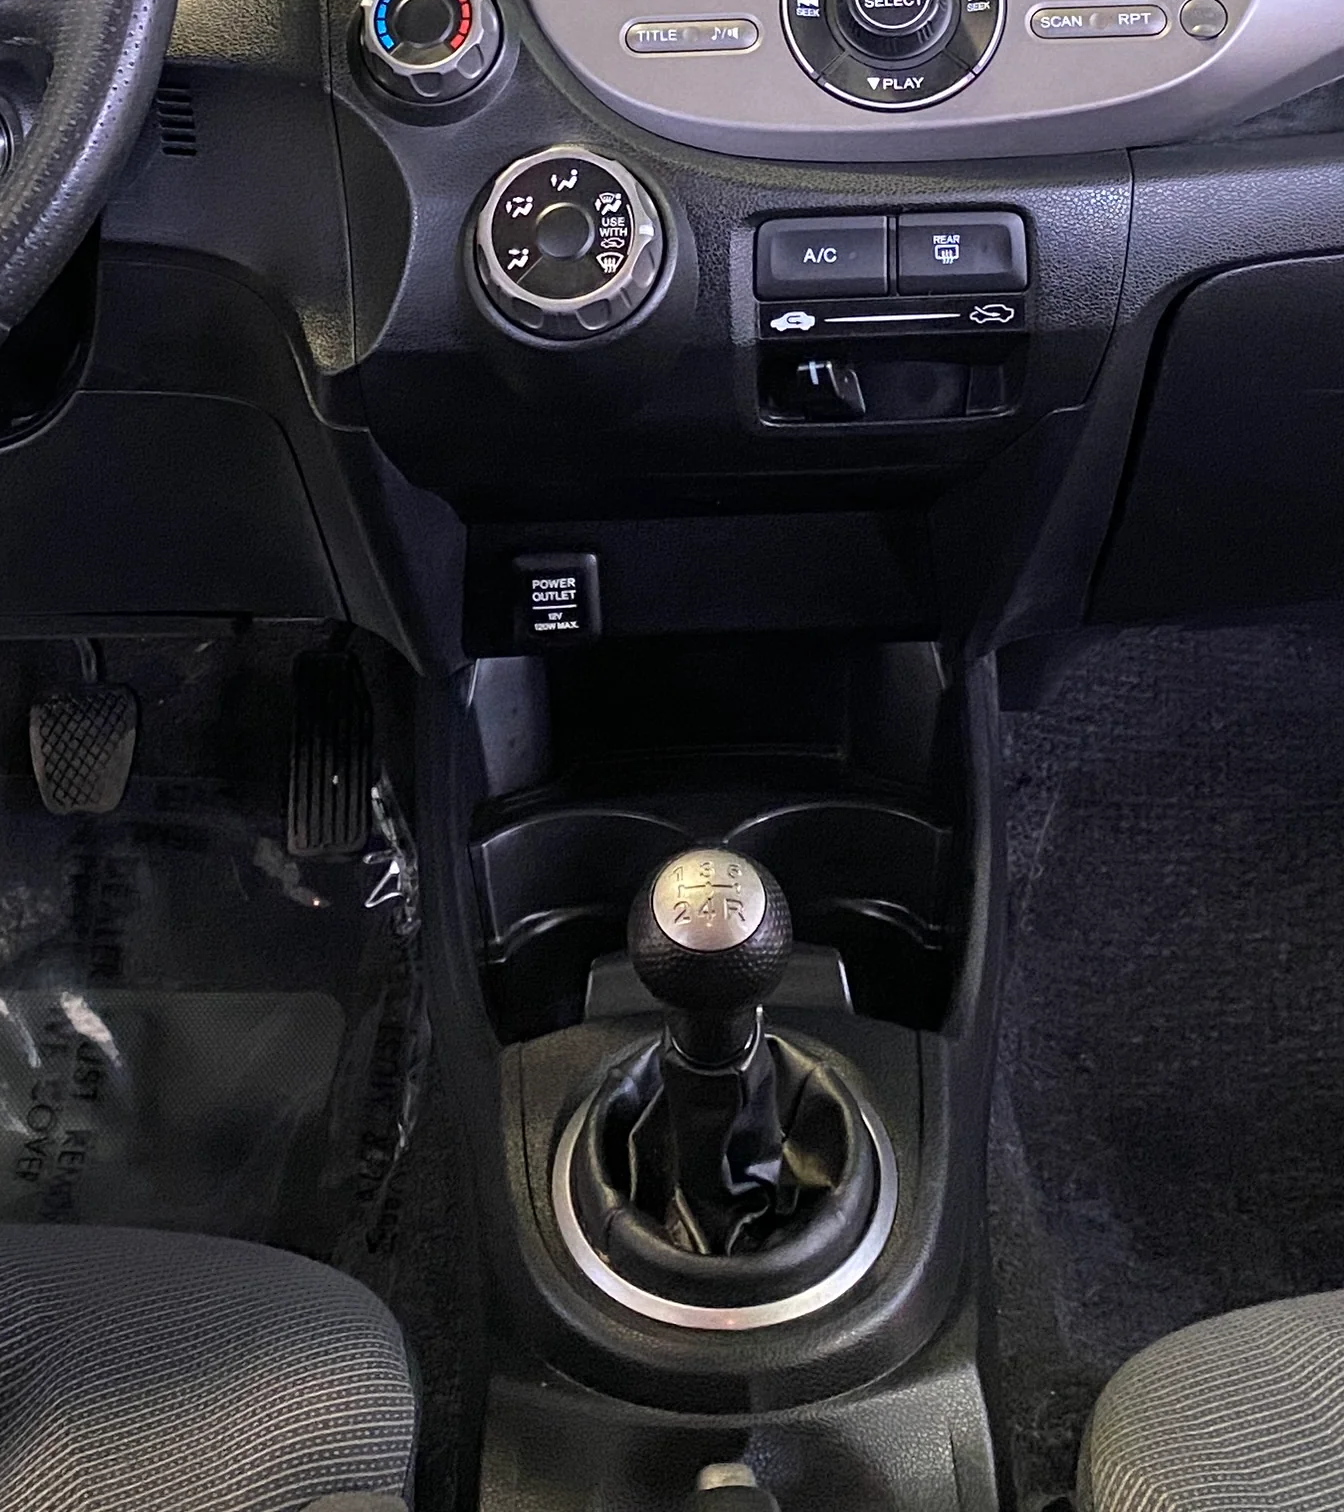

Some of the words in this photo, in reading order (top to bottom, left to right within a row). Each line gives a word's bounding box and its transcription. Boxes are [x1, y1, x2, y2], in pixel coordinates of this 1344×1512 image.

[796, 7, 820, 17] SEEK
[967, 1, 991, 12] SEEK
[1040, 15, 1083, 29] SCAN
[1118, 12, 1152, 26] RPT
[636, 29, 678, 43] TITLE
[882, 76, 925, 90] PLAY
[601, 216, 625, 227] USE
[599, 227, 628, 238] WITH
[933, 235, 961, 245] REAR
[803, 247, 838, 263] A/C
[532, 577, 576, 589] POWER
[532, 589, 577, 602] OUTLET
[548, 612, 563, 621] 12V
[669, 866, 684, 881] 1
[700, 861, 716, 878] 3
[673, 900, 692, 925] 2
[697, 896, 717, 920] 4
[723, 897, 746, 921] R
